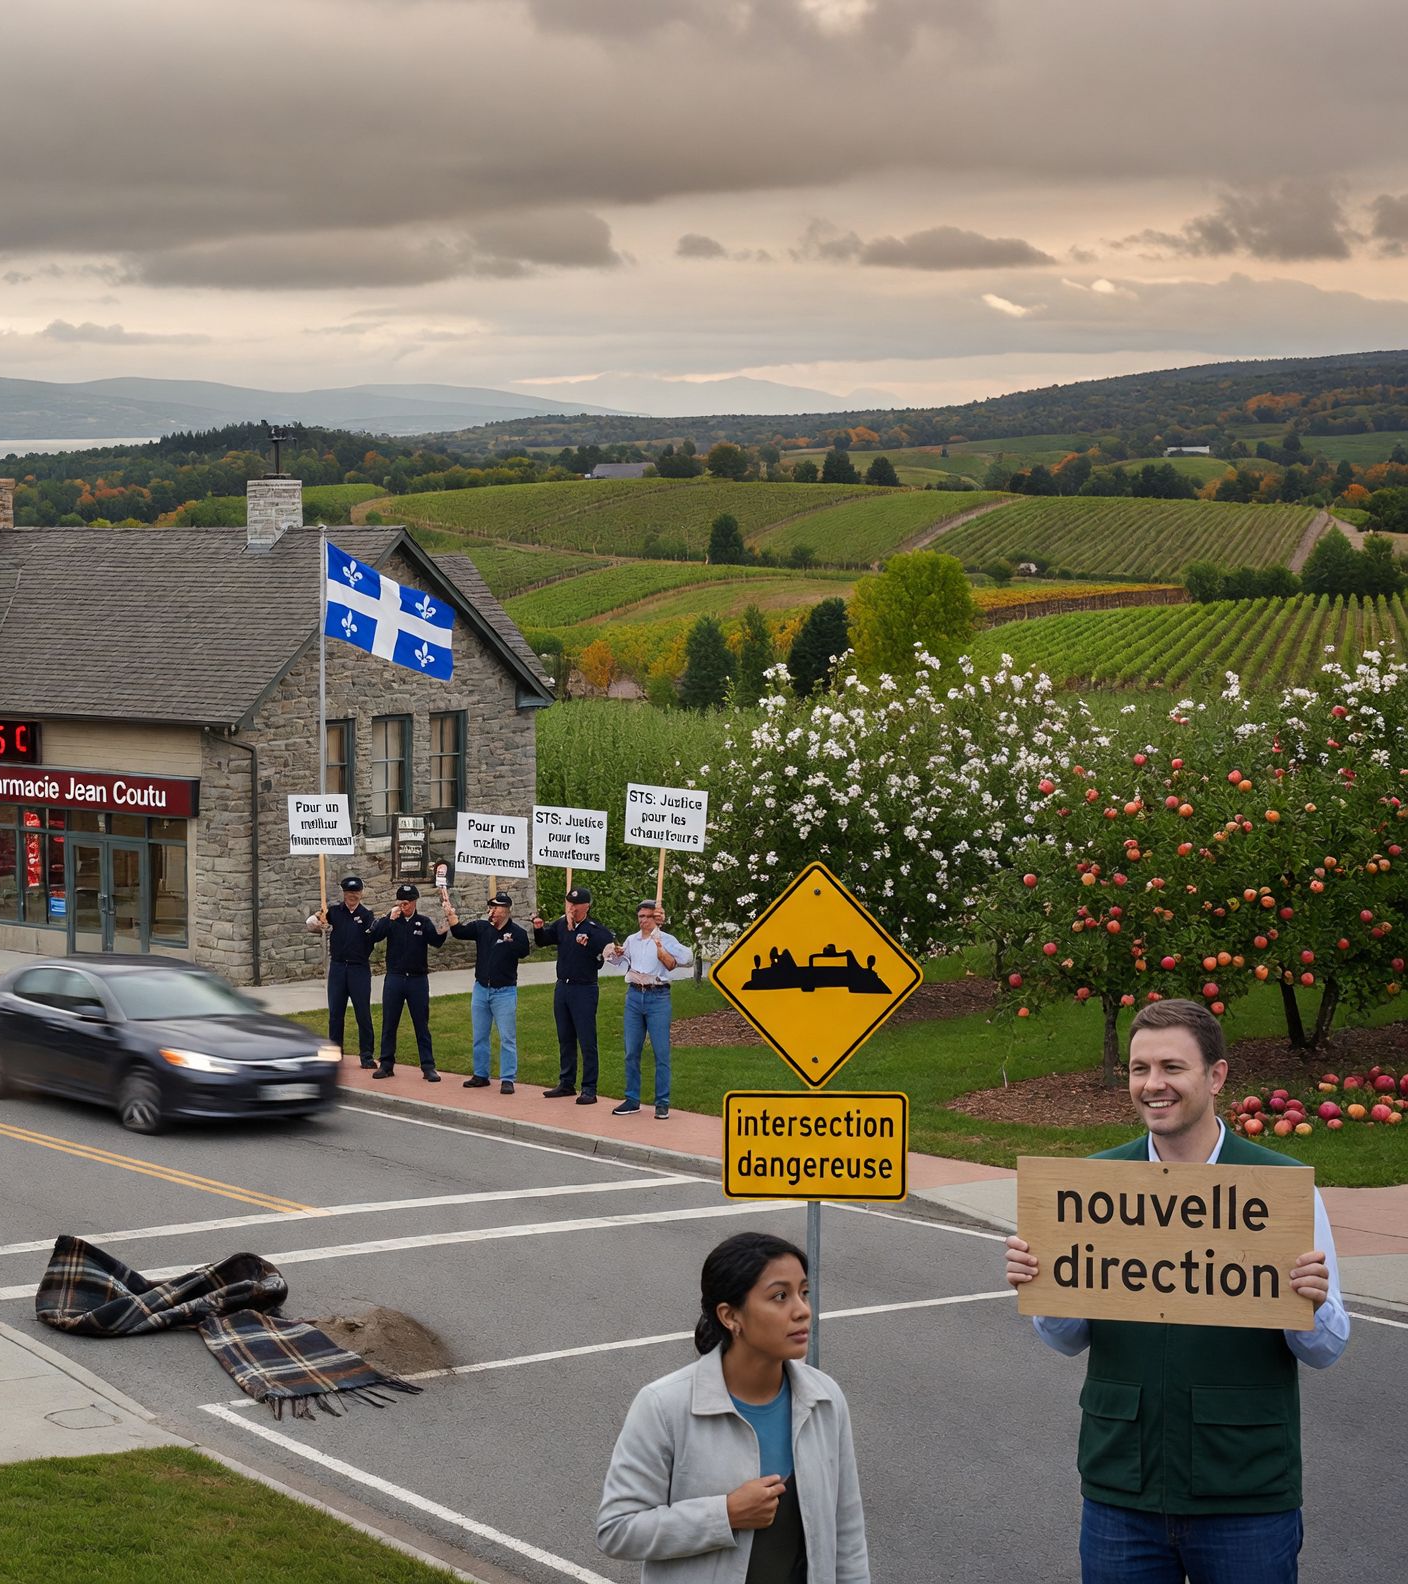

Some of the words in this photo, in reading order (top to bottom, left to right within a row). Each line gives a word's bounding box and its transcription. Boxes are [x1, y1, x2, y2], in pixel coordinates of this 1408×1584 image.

[15, 725, 27, 753] C
[65, 777, 107, 803] Jean
[112, 780, 167, 808] Coutu
[629, 790, 656, 805] STS:
[295, 801, 322, 813] Pour
[325, 803, 339, 813] un
[535, 811, 562, 825] STS:
[468, 818, 496, 833] Pour
[500, 824, 516, 835] un
[641, 812, 667, 824] pour
[671, 812, 687, 826] les
[548, 832, 571, 843] pour
[575, 832, 590, 845] les
[737, 1108, 894, 1138] intersection
[737, 1149, 893, 1186] dangereuse
[1057, 1183, 1270, 1232] nouvelle
[1053, 1243, 1280, 1299] direction
